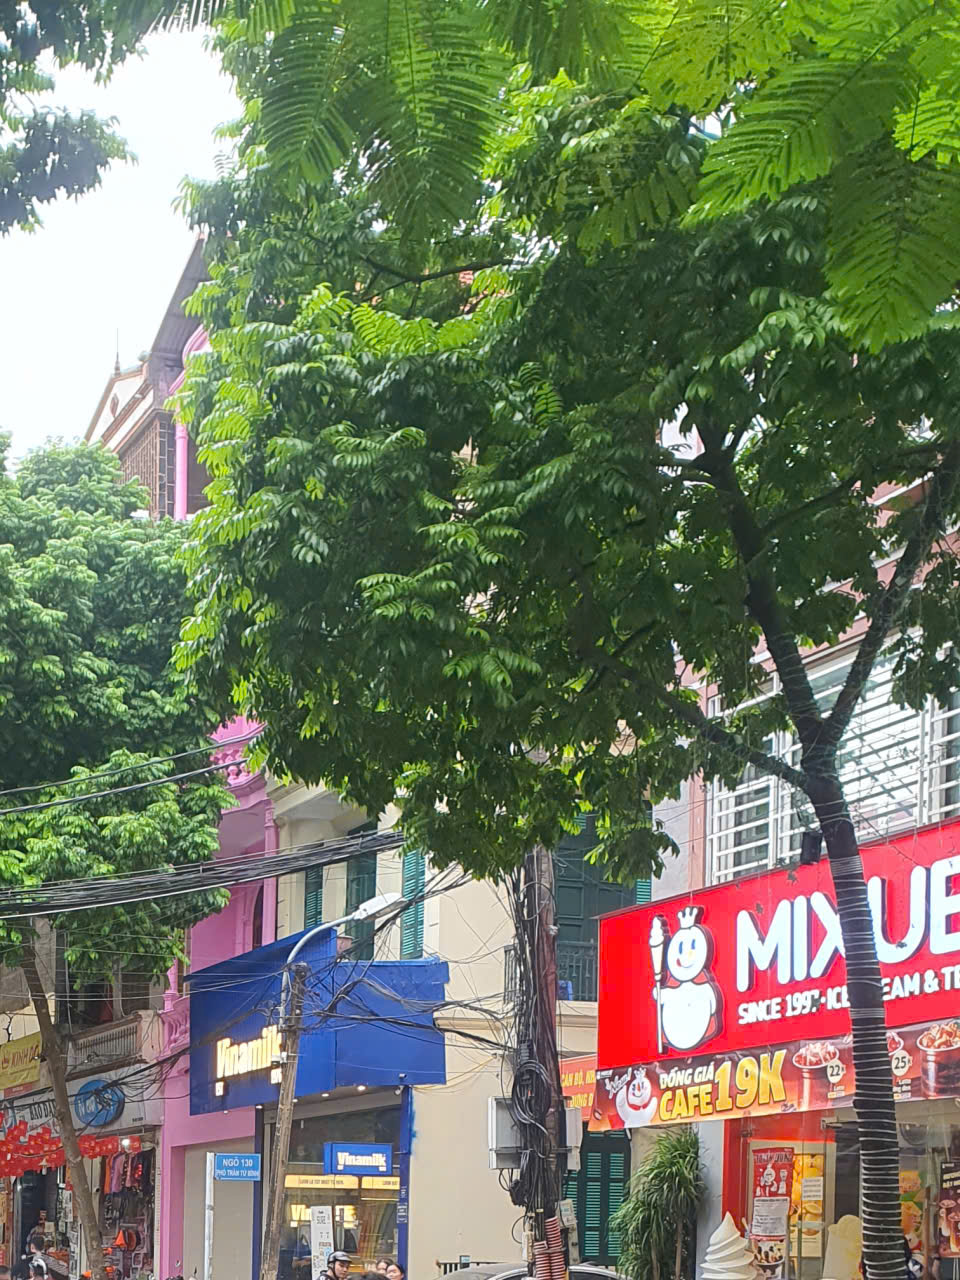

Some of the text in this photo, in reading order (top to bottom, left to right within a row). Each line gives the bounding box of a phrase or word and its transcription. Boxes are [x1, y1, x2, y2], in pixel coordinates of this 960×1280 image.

[738, 997, 782, 1024] SINCE
[923, 969, 940, 993] &
[693, 1061, 714, 1084] GIÁ
[658, 1049, 787, 1121] CAFE 19K
[240, 1158, 253, 1167] 130
[337, 1152, 386, 1167] Vinamilk
